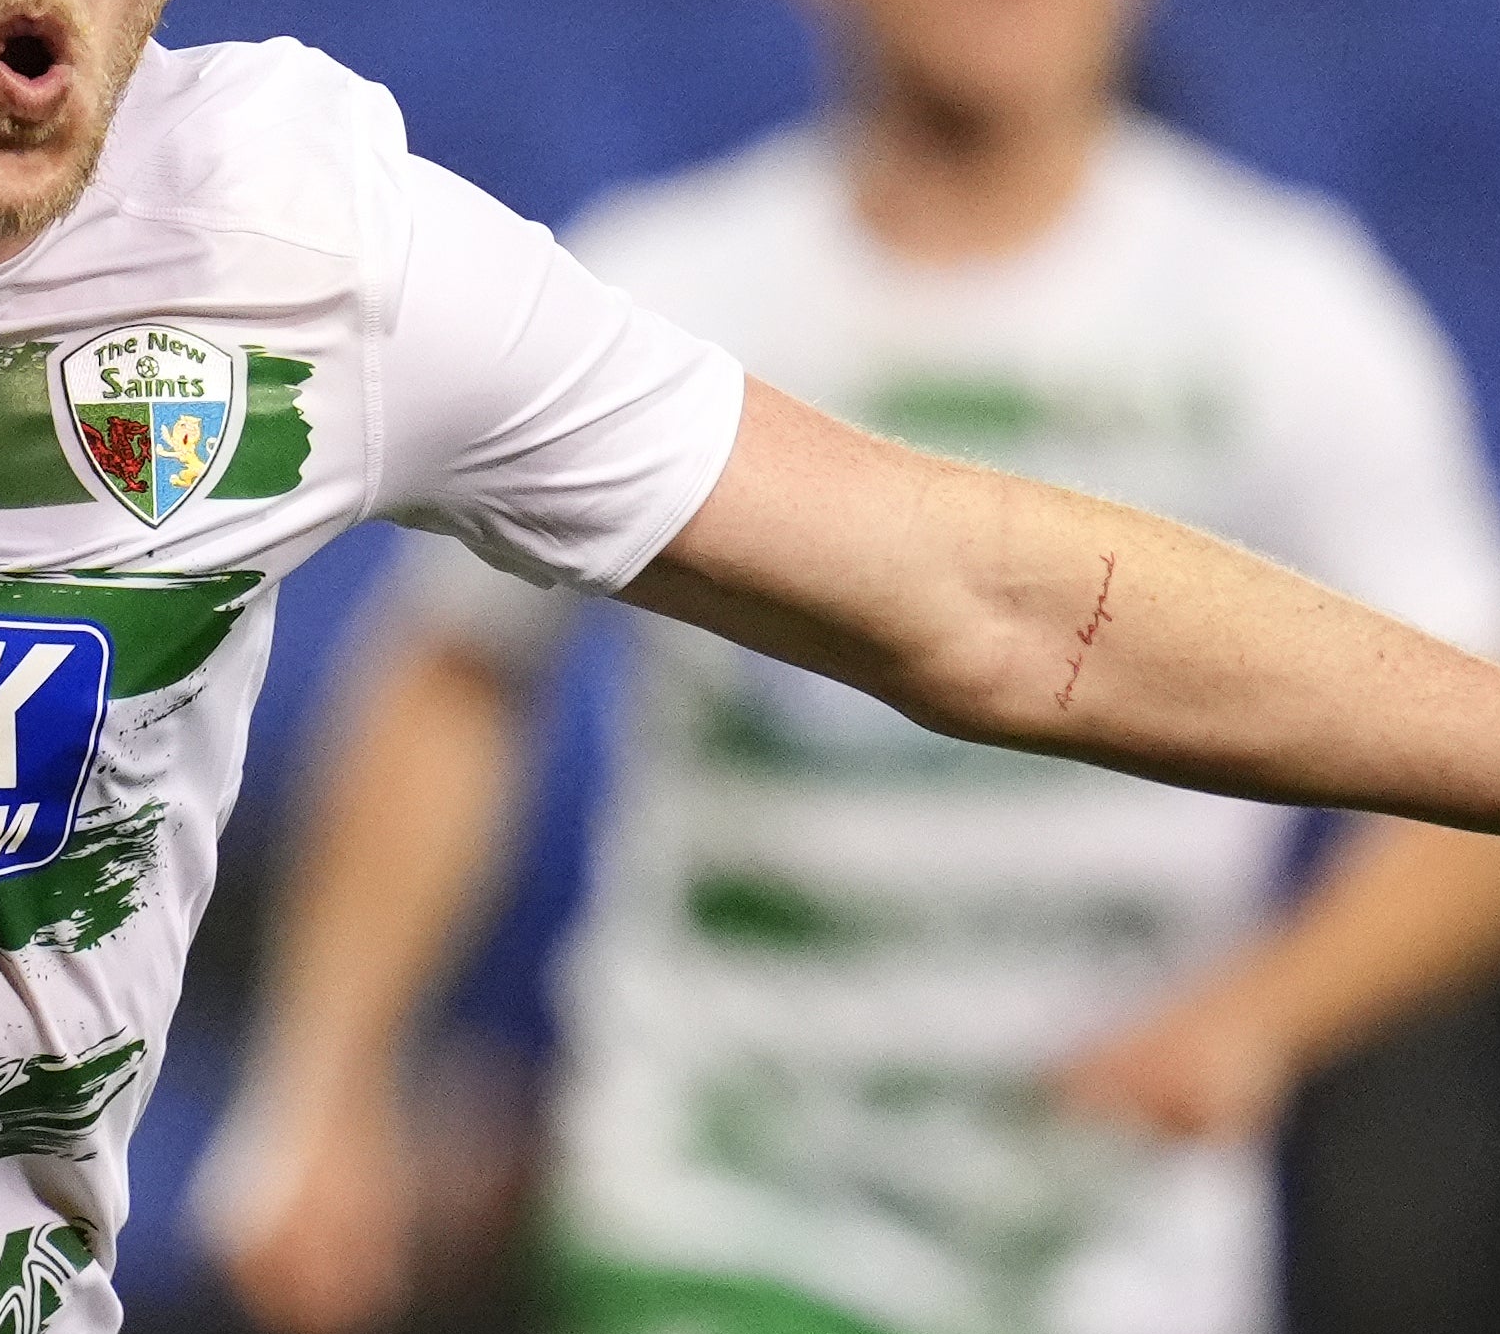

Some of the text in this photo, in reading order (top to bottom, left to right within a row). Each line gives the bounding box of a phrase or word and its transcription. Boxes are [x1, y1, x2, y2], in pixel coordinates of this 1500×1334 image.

[93, 331, 207, 368] The New
[100, 366, 206, 399] Saints
